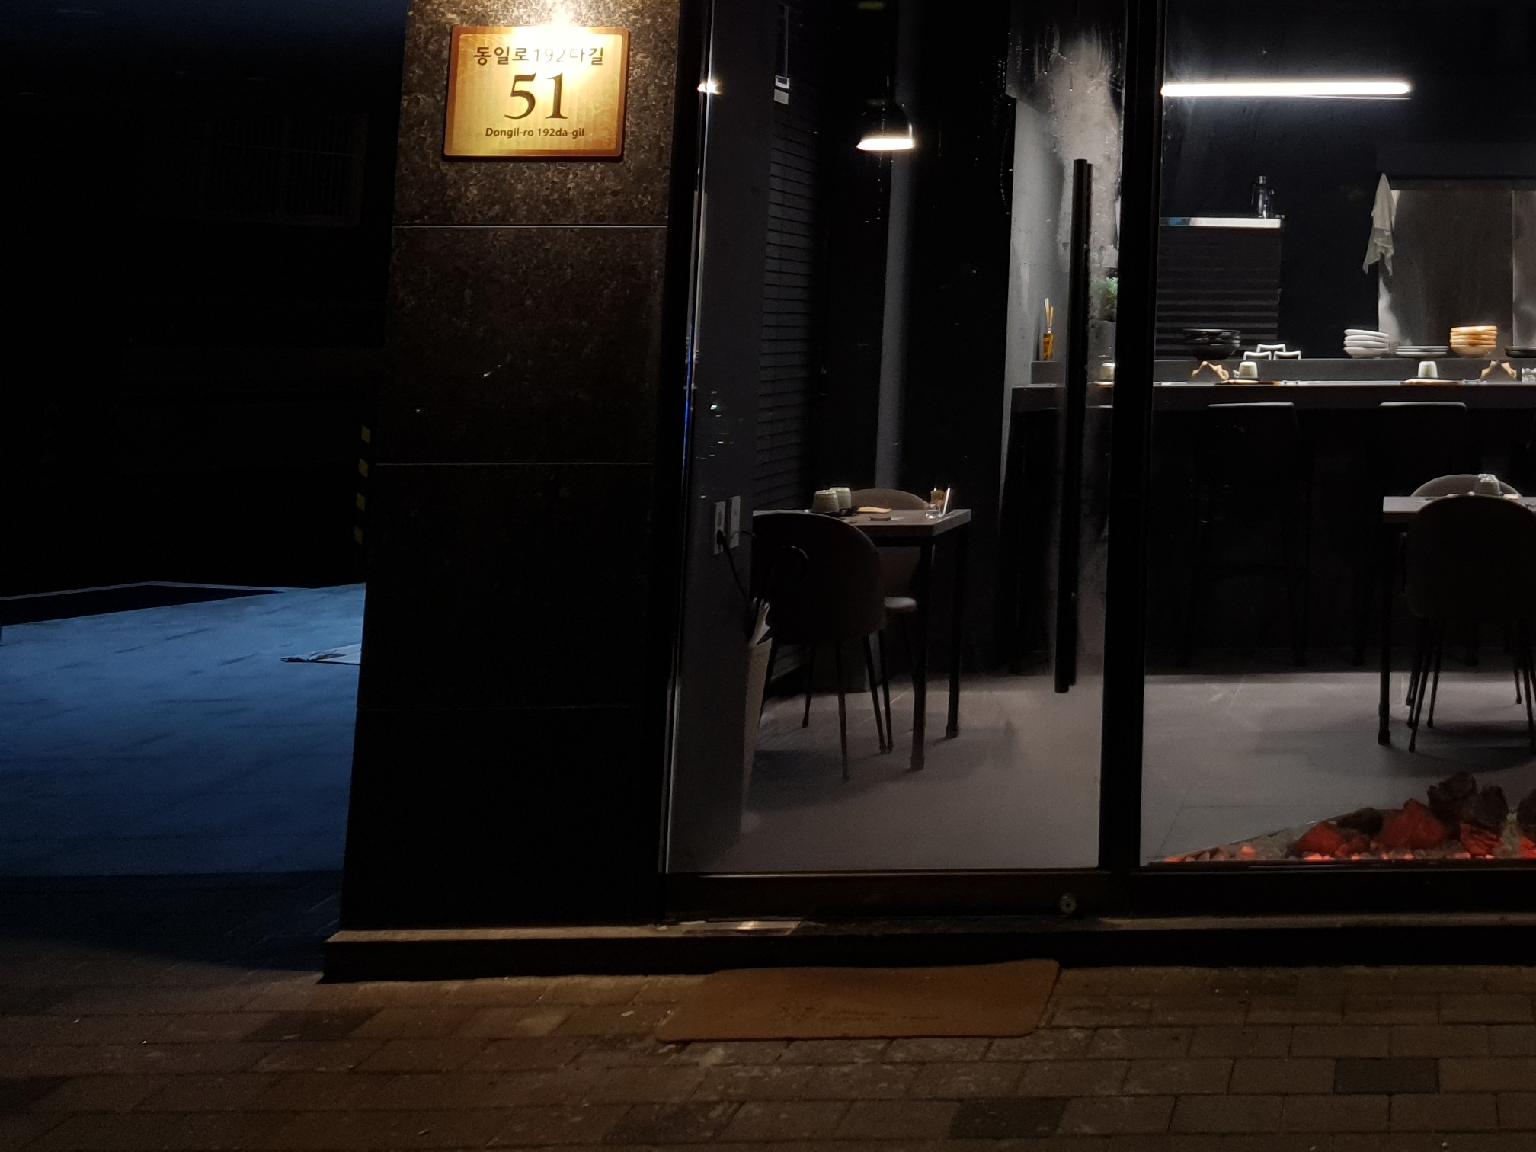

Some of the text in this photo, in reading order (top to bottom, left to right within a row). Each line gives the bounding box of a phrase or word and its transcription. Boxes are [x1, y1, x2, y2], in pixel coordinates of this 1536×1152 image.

[473, 46, 604, 66] 동일로192다길
[504, 72, 569, 120] 51
[485, 127, 585, 139] Dongil-ro 192da-gil
